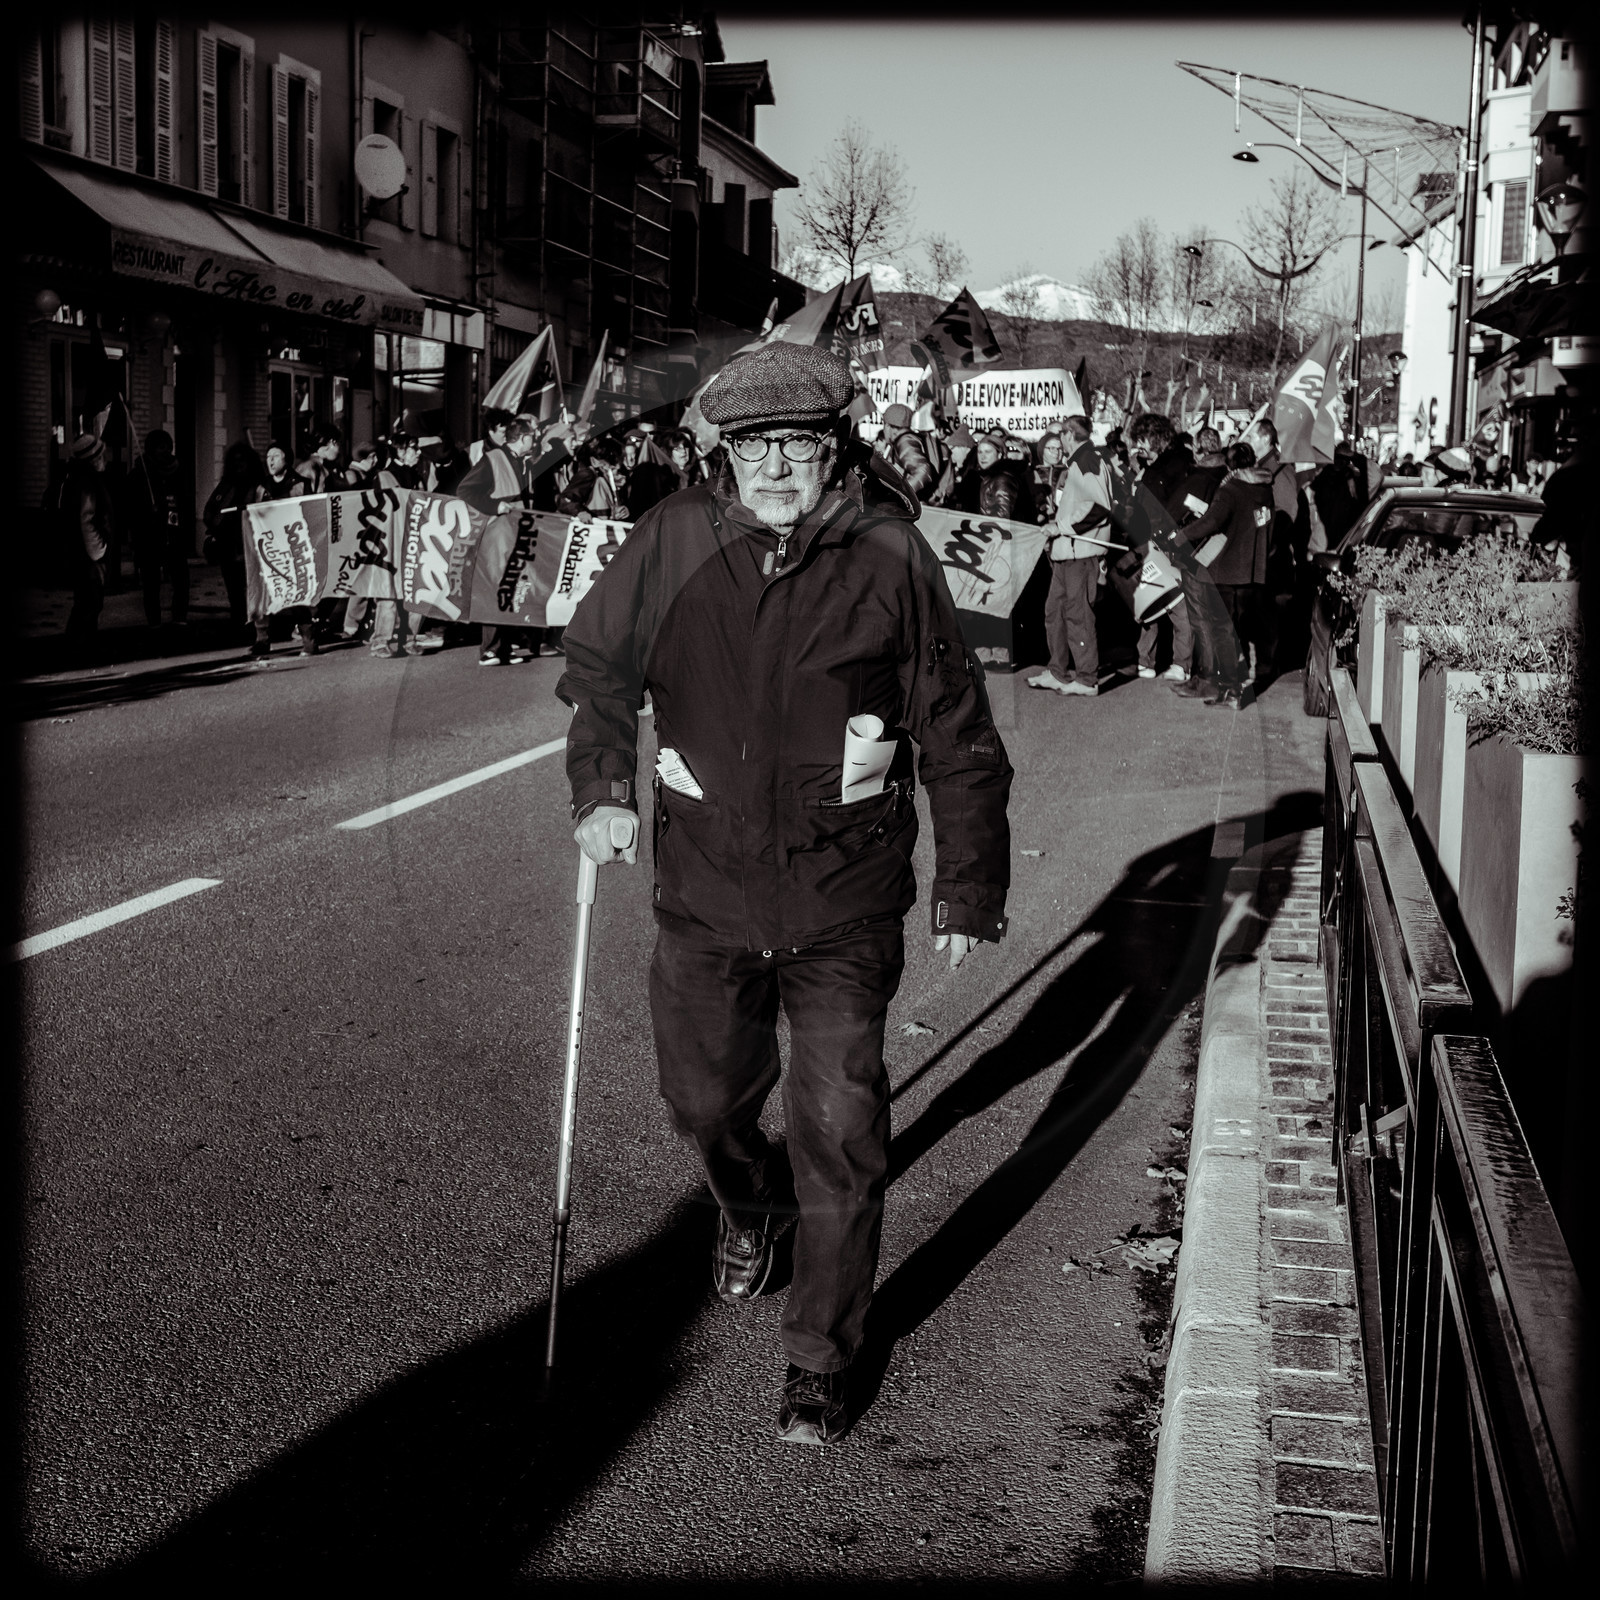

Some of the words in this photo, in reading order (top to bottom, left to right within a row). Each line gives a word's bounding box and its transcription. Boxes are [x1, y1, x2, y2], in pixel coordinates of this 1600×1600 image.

[113, 240, 185, 276] RESTAURANT
[194, 257, 276, 301] l'Arc
[286, 292, 313, 310] en
[322, 294, 366, 320] ciel
[958, 381, 1064, 407] DELEVOYE-MACRON
[333, 552, 361, 597] Rail
[403, 497, 431, 603] Territoriaux
[415, 499, 471, 621] Sud
